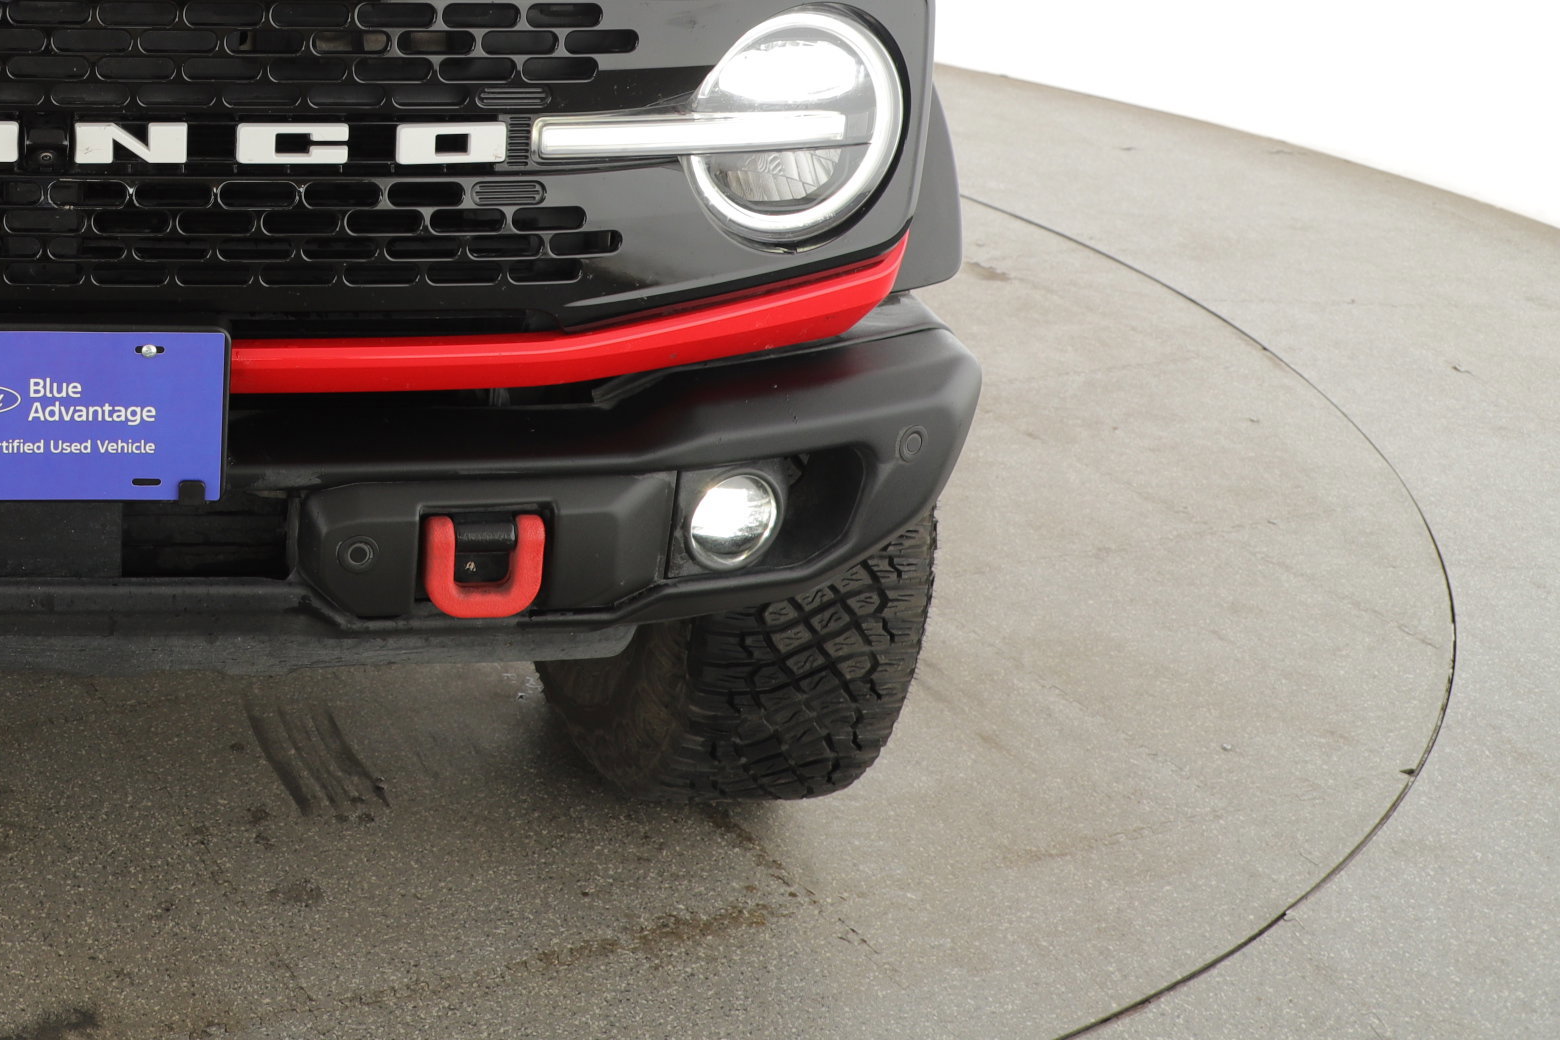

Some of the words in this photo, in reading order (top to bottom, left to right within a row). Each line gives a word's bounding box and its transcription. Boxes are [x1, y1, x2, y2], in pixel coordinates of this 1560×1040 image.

[29, 378, 82, 398] Blue
[28, 401, 156, 426] Advantage
[50, 439, 91, 454] Used
[96, 439, 156, 454] Vehicle
